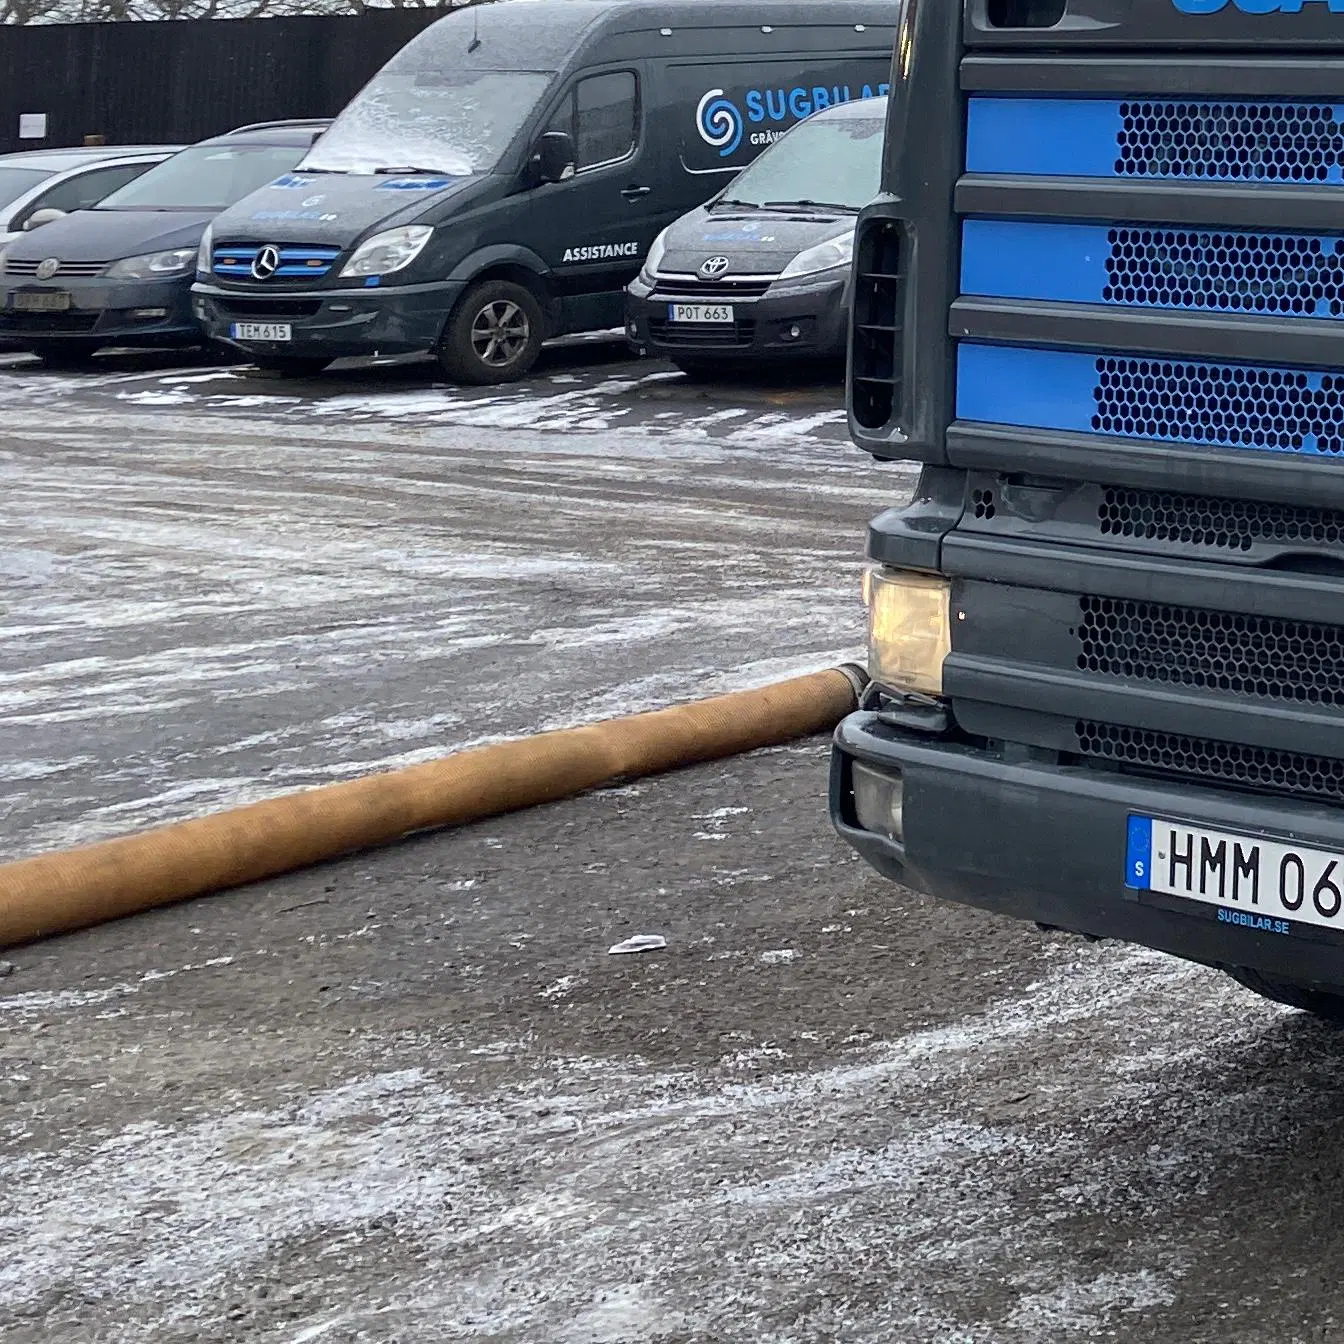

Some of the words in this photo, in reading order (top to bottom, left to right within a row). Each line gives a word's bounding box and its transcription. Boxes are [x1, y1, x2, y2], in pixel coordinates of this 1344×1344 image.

[562, 242, 638, 263] ASSISTANCE
[703, 307, 729, 320] 663
[239, 323, 261, 338] TEM
[263, 323, 287, 339] 615
[1135, 860, 1144, 877] S
[1169, 830, 1260, 905] HMM
[1217, 908, 1290, 935] SUGBILAR.SE
